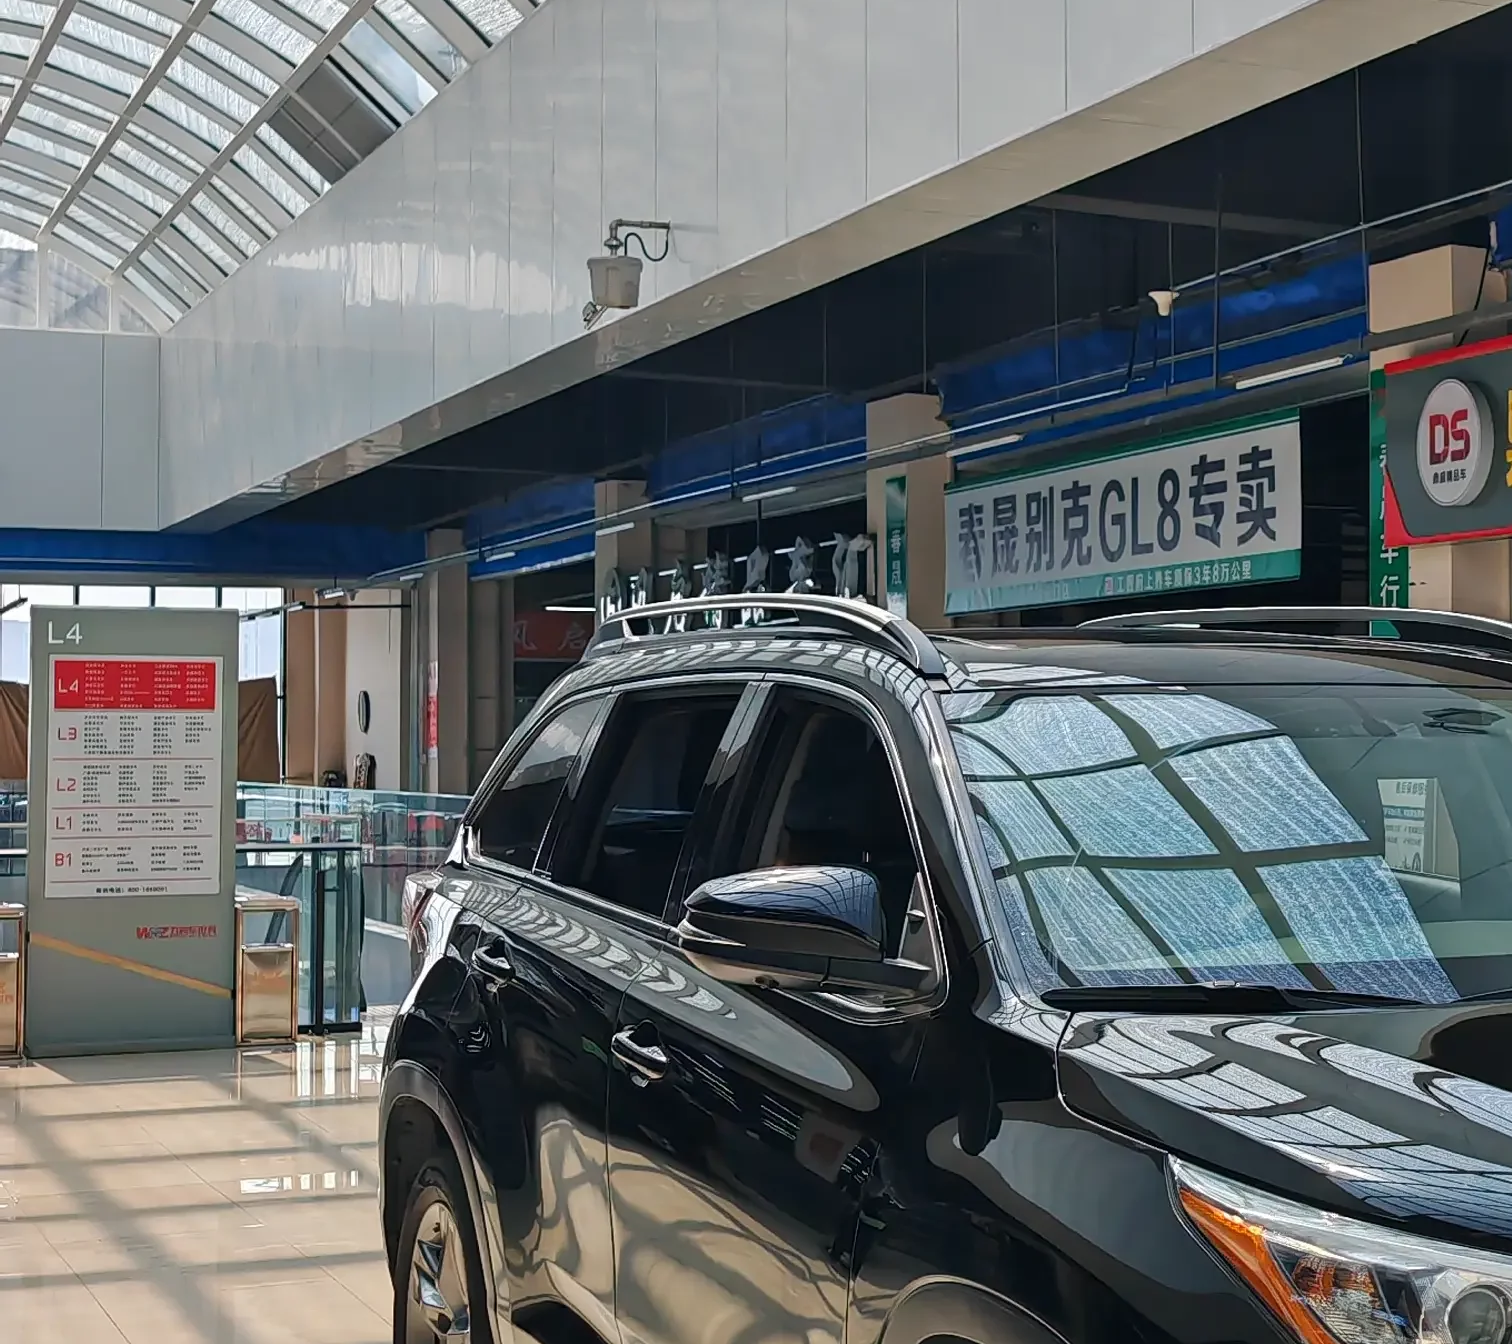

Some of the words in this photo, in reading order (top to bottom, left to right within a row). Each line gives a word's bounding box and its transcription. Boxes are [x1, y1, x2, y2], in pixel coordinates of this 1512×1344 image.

[1429, 408, 1471, 466] DS
[47, 621, 83, 645] L4
[57, 678, 79, 694] L4
[57, 726, 78, 741] L3
[56, 777, 77, 792] L2
[55, 815, 73, 830] L1
[54, 852, 73, 868] B1
